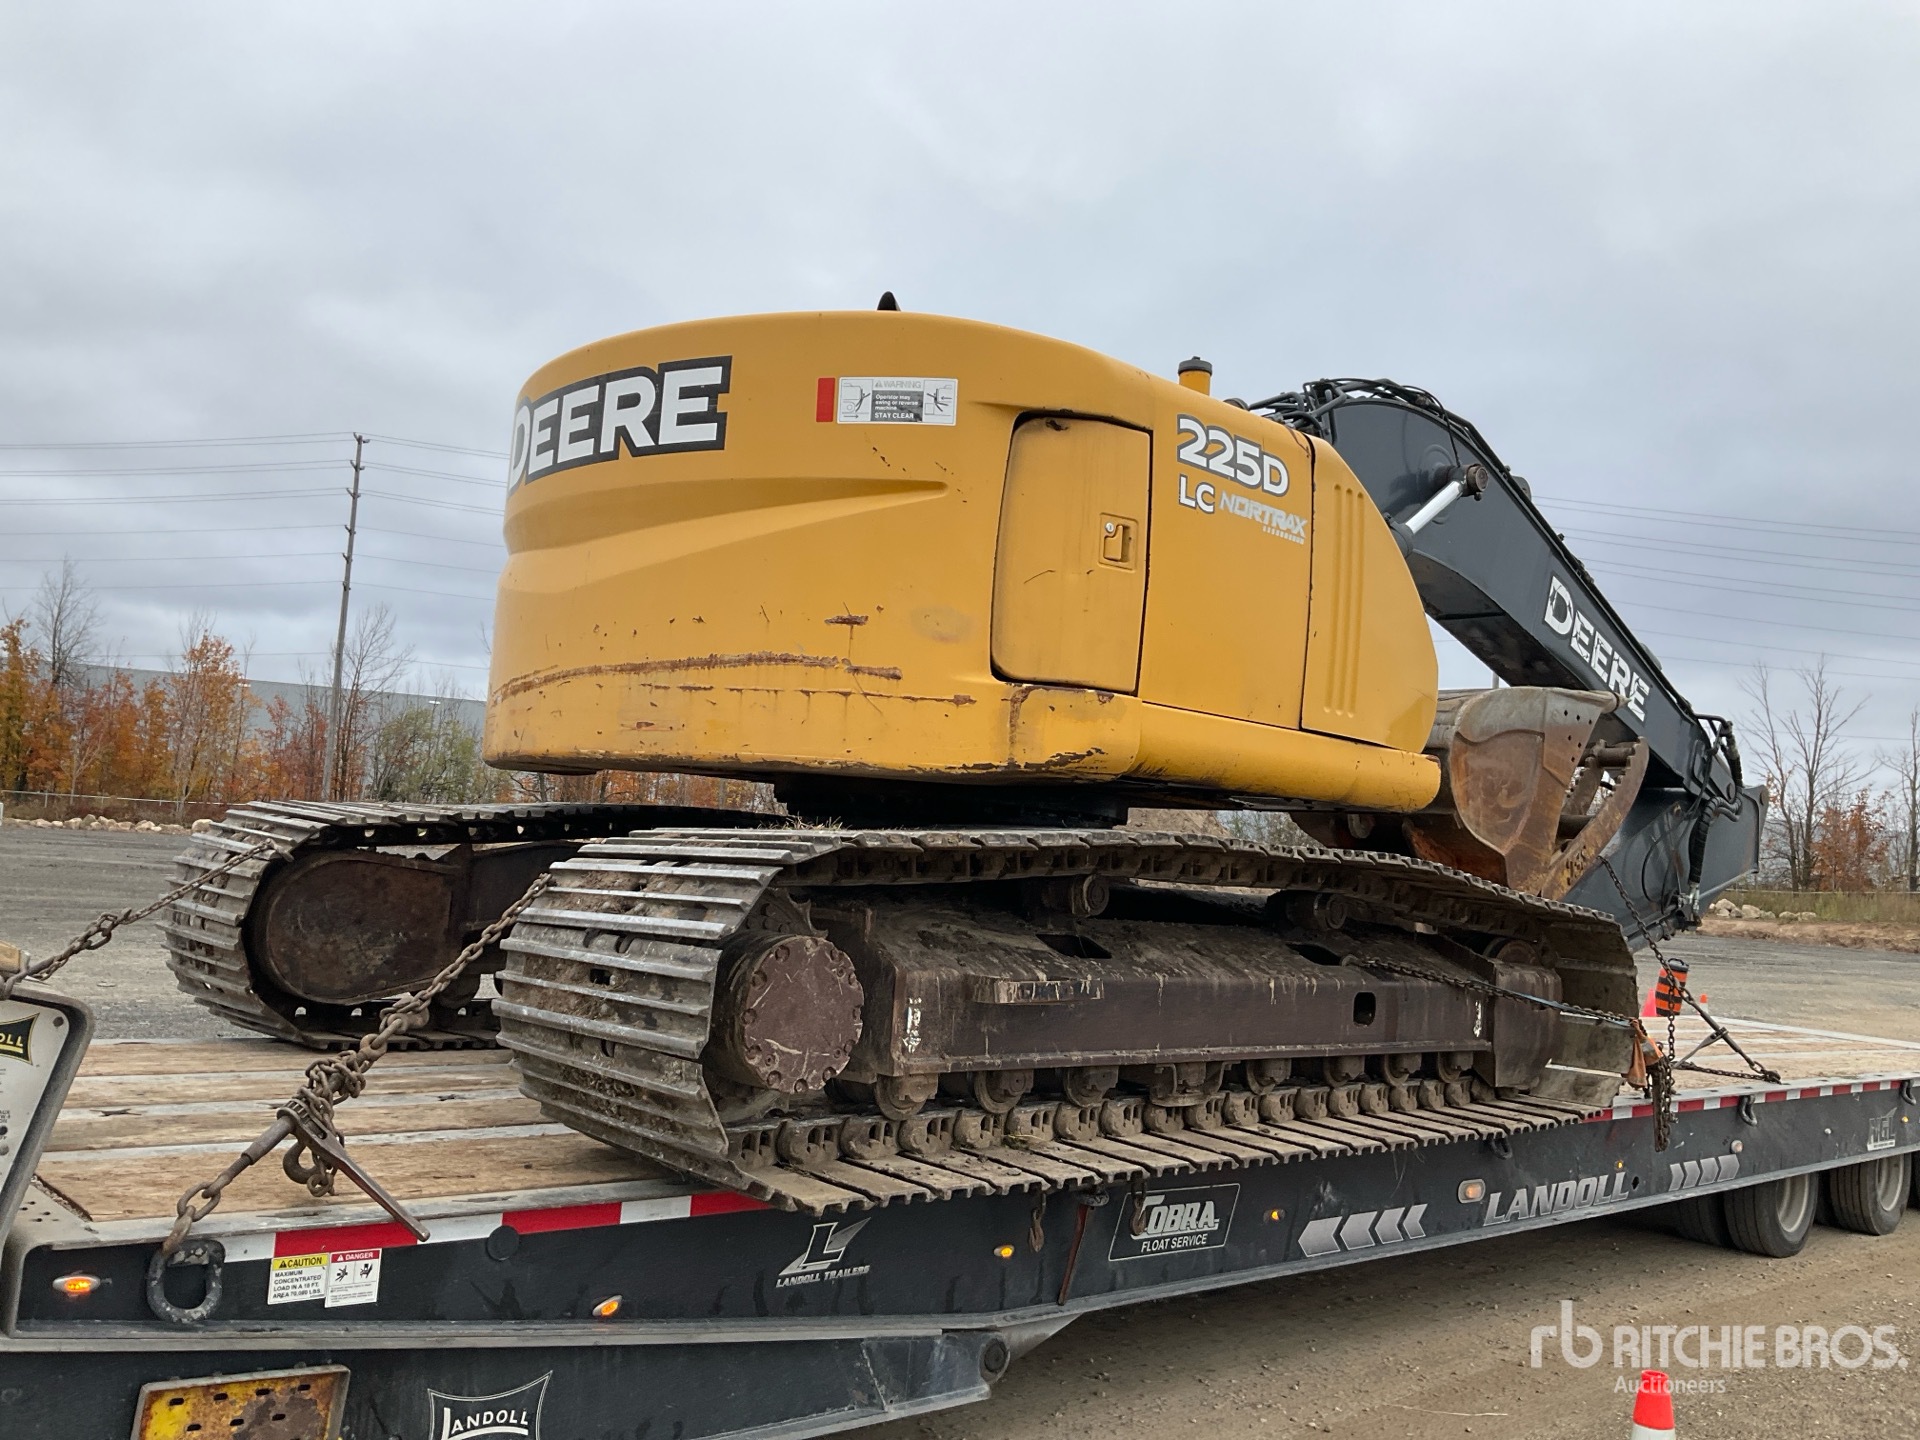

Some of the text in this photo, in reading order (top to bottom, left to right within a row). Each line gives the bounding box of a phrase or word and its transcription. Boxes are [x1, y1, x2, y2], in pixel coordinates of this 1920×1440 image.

[883, 380, 921, 389] WARNING
[508, 365, 724, 492] DEERE
[1178, 416, 1290, 497] 225D
[1179, 475, 1308, 537] LC NORTRAX
[1544, 575, 1650, 722] DEERE
[1483, 1171, 1630, 1227] LANDOLL
[1140, 1233, 1208, 1253] FLOAT SERVICE
[287, 1256, 323, 1268] CAUTION
[345, 1251, 374, 1261] DANGER
[273, 1274, 322, 1285] CONCENTRATED
[274, 1270, 303, 1278] MAXIMUM
[775, 1264, 871, 1288] LANDOLL TRAILERS
[272, 1291, 290, 1299] AREA
[441, 1407, 530, 1440] LANDOLL
